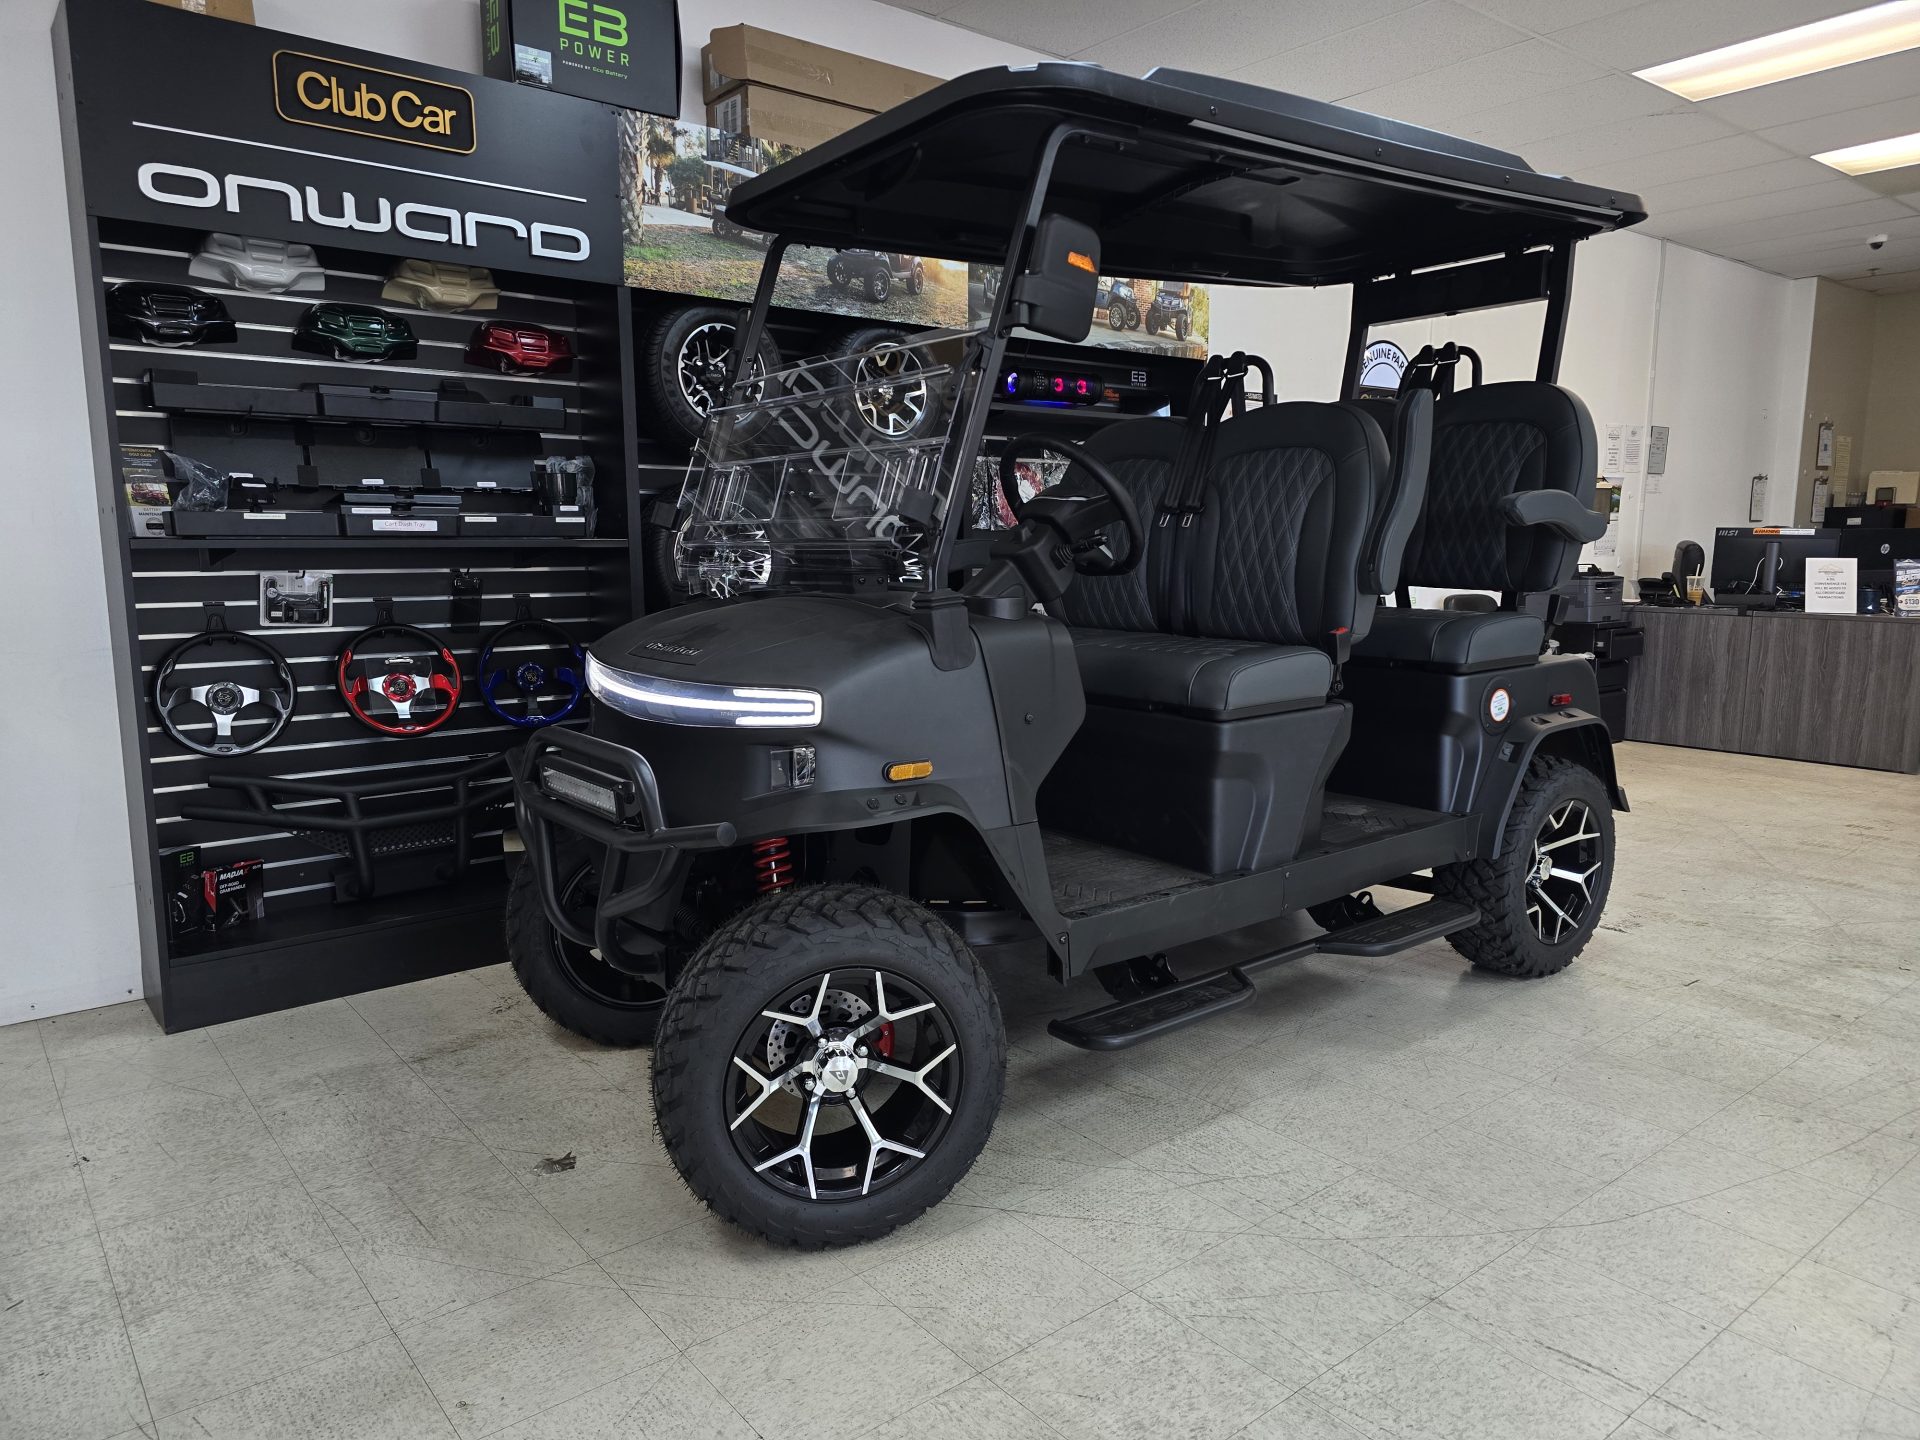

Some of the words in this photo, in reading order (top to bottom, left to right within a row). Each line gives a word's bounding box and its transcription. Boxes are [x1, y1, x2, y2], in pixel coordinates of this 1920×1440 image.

[558, 0, 629, 47] EB
[560, 38, 630, 67] POWER
[605, 70, 628, 80] Battery
[297, 71, 387, 122] Club
[392, 90, 457, 135] Car
[1391, 352, 1405, 370] PAR
[1131, 371, 1147, 383] EB
